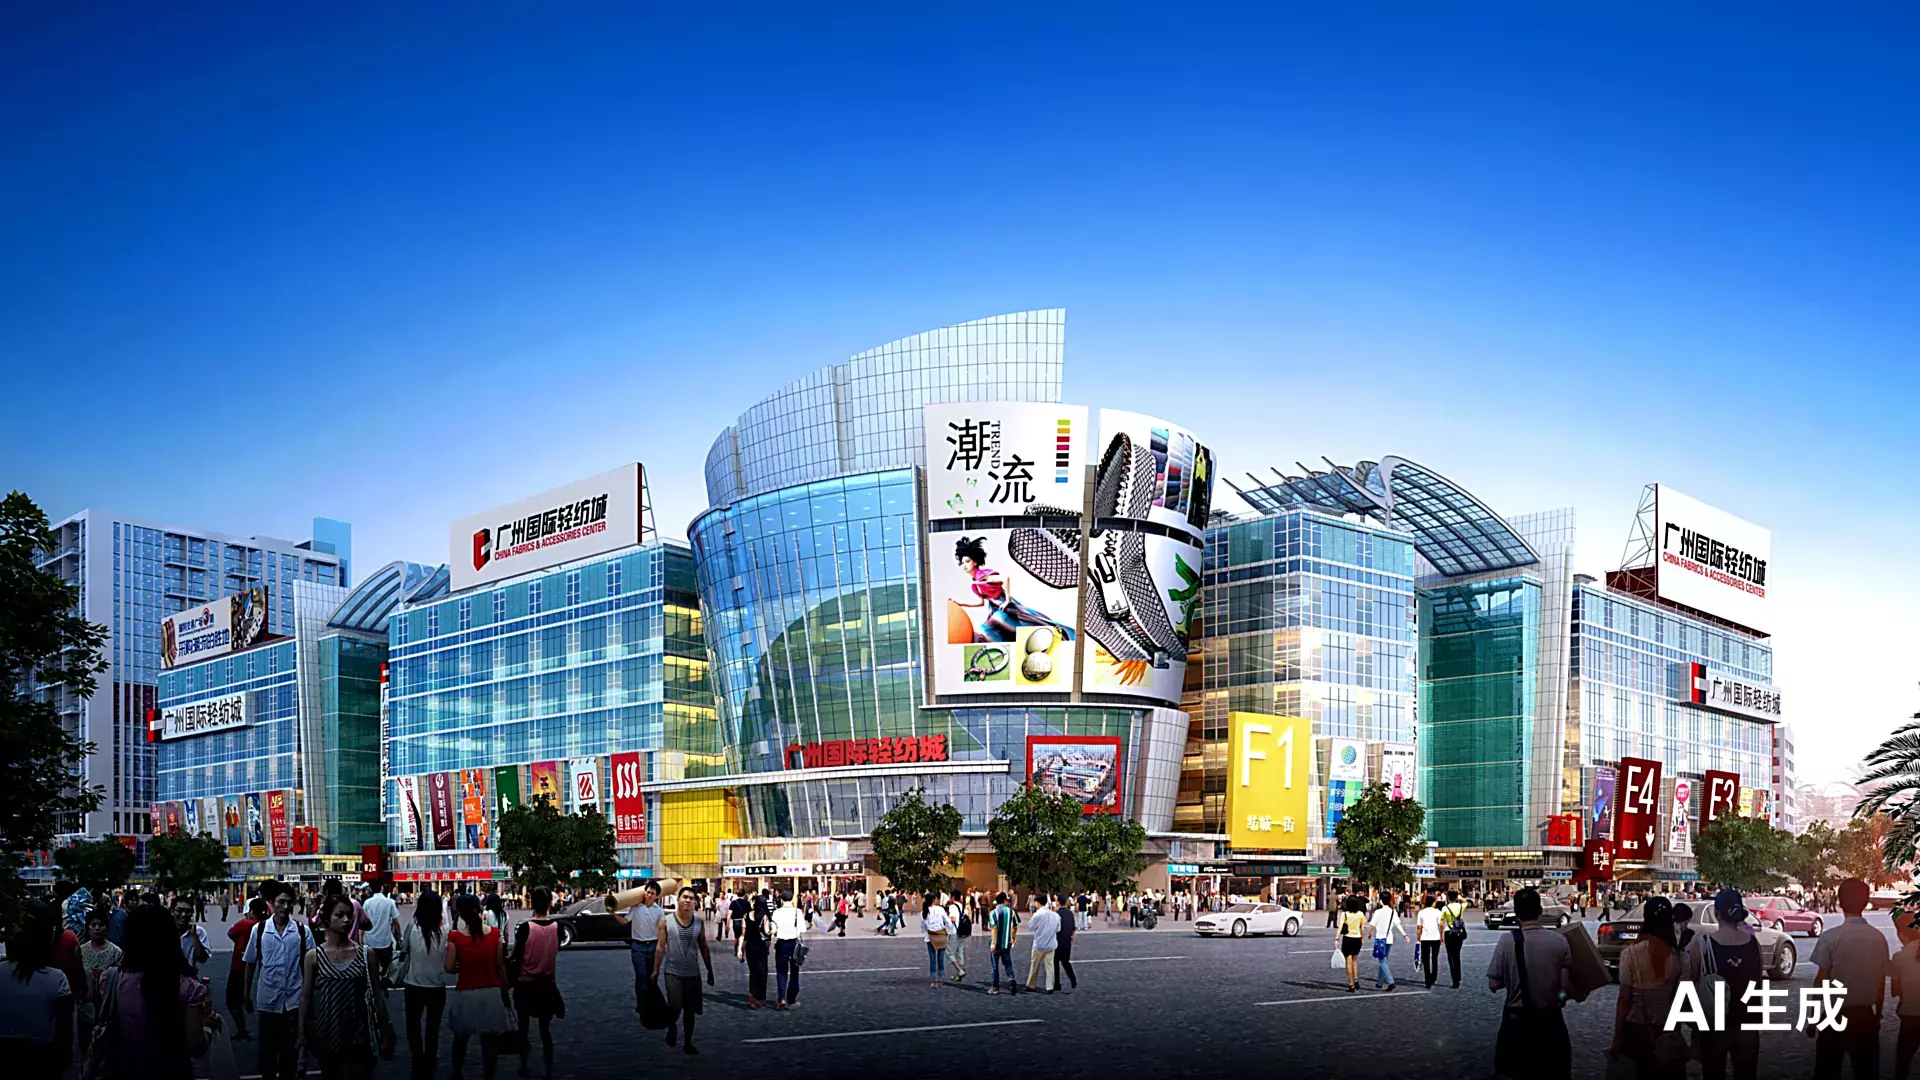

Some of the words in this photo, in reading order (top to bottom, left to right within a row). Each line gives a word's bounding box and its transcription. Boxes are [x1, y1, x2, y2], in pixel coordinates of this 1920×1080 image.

[946, 418, 990, 471] 潮
[991, 420, 1001, 469] TREND
[988, 453, 1036, 504] 流
[494, 549, 511, 561] CHINA
[512, 541, 535, 556] FABRICS
[535, 540, 541, 549] &
[542, 529, 581, 548] ACCESSORIES
[582, 521, 606, 536] CENTER
[496, 494, 608, 550] 广州国际轻纺城
[1663, 522, 1766, 586] 广州国际轻纺城
[1663, 551, 1680, 566] CHINA
[1681, 558, 1703, 575] FABRICS
[1709, 569, 1745, 591] ACCESSORIES
[1746, 583, 1766, 598] CENTER
[164, 696, 242, 735] 广州国际轻纺城
[1712, 677, 1780, 714] 广州国际轻纺城
[784, 734, 949, 770] 广州国际轻纺城
[1241, 723, 1294, 789] F1
[1624, 765, 1655, 814] E4
[1709, 778, 1735, 820] E3
